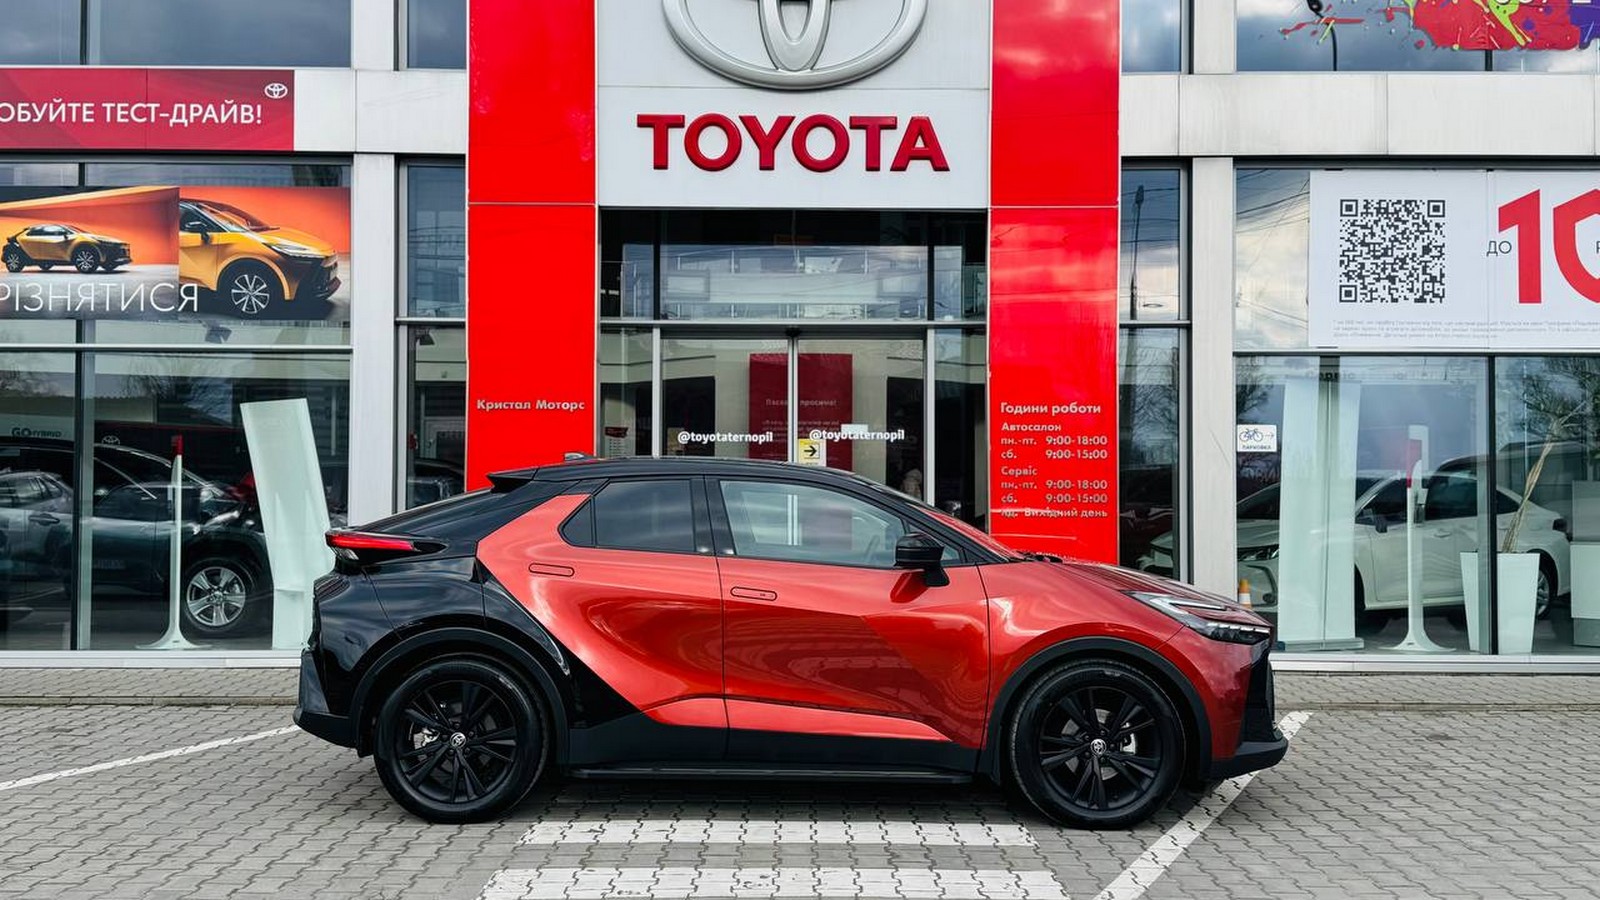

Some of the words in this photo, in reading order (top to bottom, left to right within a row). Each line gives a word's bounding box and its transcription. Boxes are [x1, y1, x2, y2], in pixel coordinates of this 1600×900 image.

[102, 99, 262, 127] ТЕСТ-ДРАЙВ!
[637, 114, 950, 172] TOYOTA
[1486, 240, 1512, 257] ДО
[477, 399, 531, 412] Кристал
[536, 399, 586, 412] Моторс
[1001, 402, 1048, 415] Години
[1052, 401, 1101, 416] роботи
[1001, 422, 1062, 432] Автосалон
[677, 430, 774, 444] @toyotaternopil
[809, 429, 905, 443] @toyotaternopil
[1001, 449, 1017, 459] сб.
[1001, 465, 1038, 477] Сервіс
[1001, 493, 1017, 503] сб.
[1081, 509, 1108, 518] день
